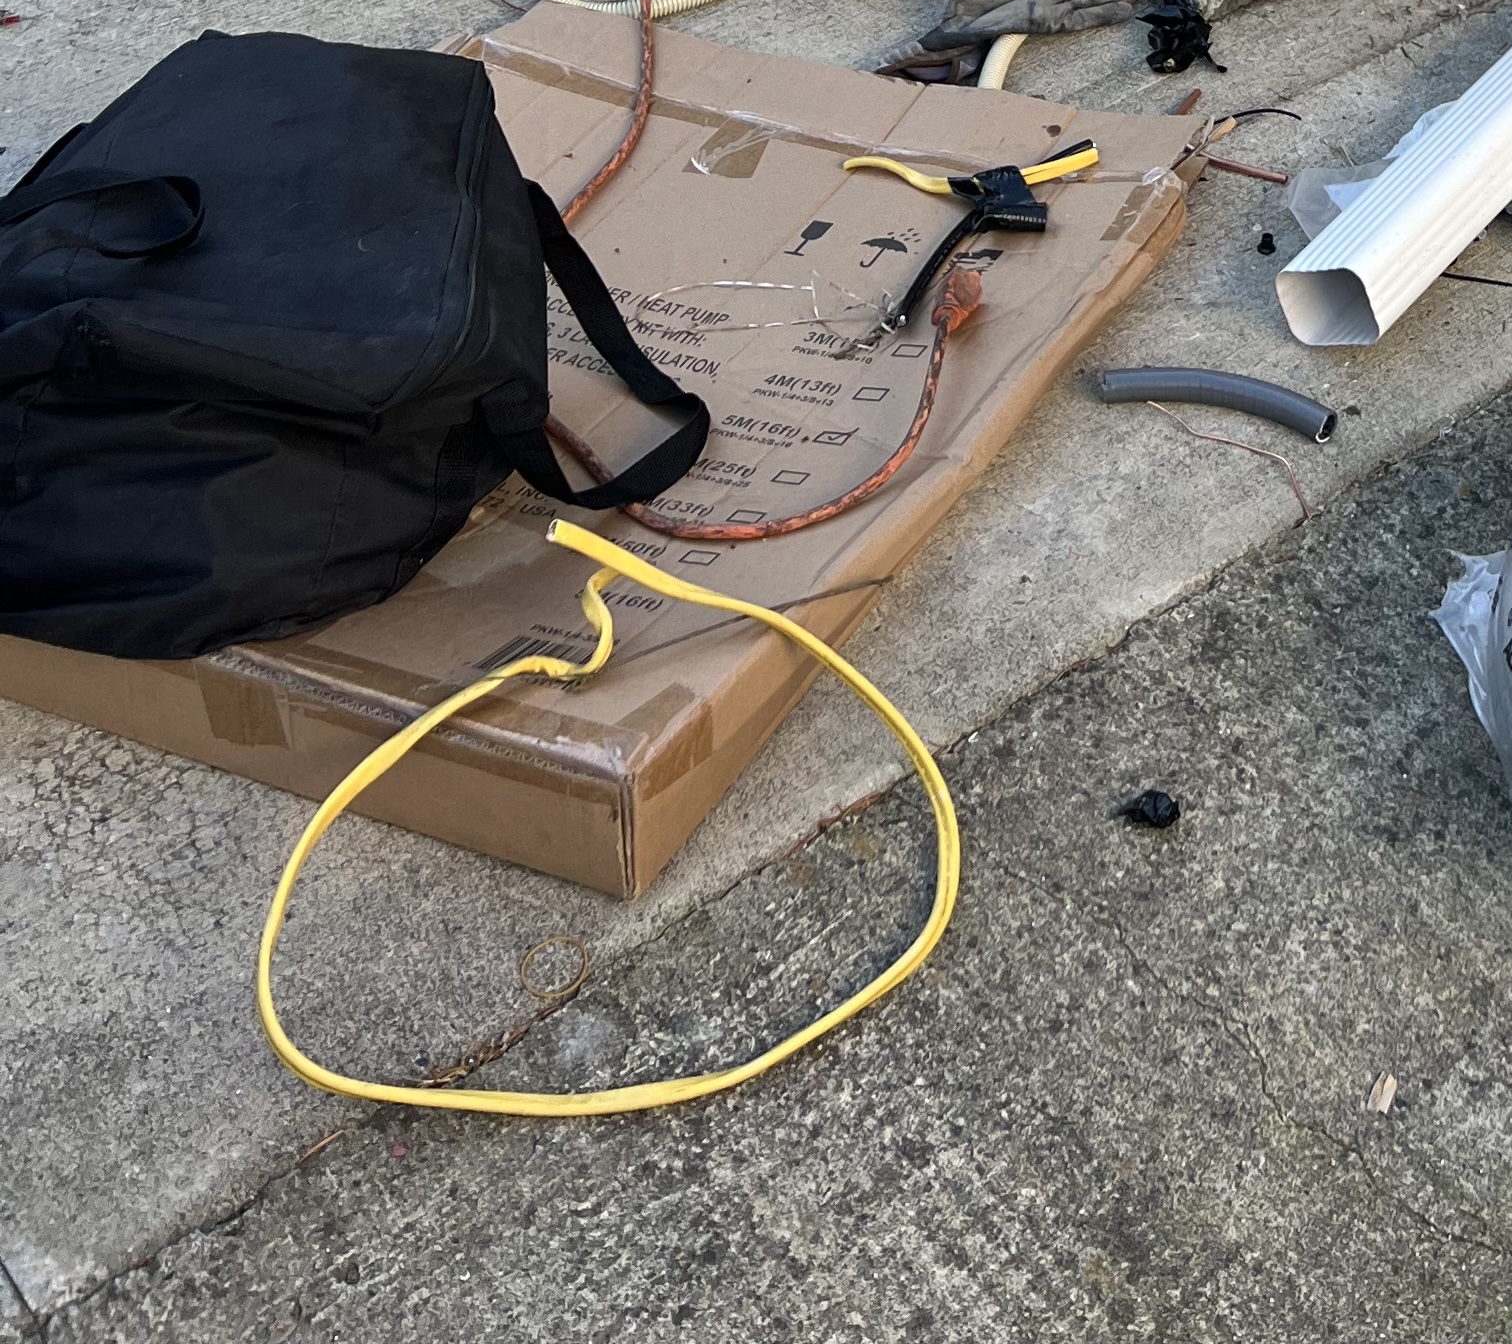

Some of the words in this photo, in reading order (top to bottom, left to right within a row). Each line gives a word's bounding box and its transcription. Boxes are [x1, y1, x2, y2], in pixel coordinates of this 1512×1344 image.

[637, 296, 685, 318] HEAT
[680, 305, 731, 327] PUMP
[632, 318, 663, 338] KIT
[661, 326, 708, 348] WITH:
[763, 373, 842, 396] 4M(13ft)
[721, 414, 801, 439] 5M(16ft)
[520, 503, 558, 519] USA
